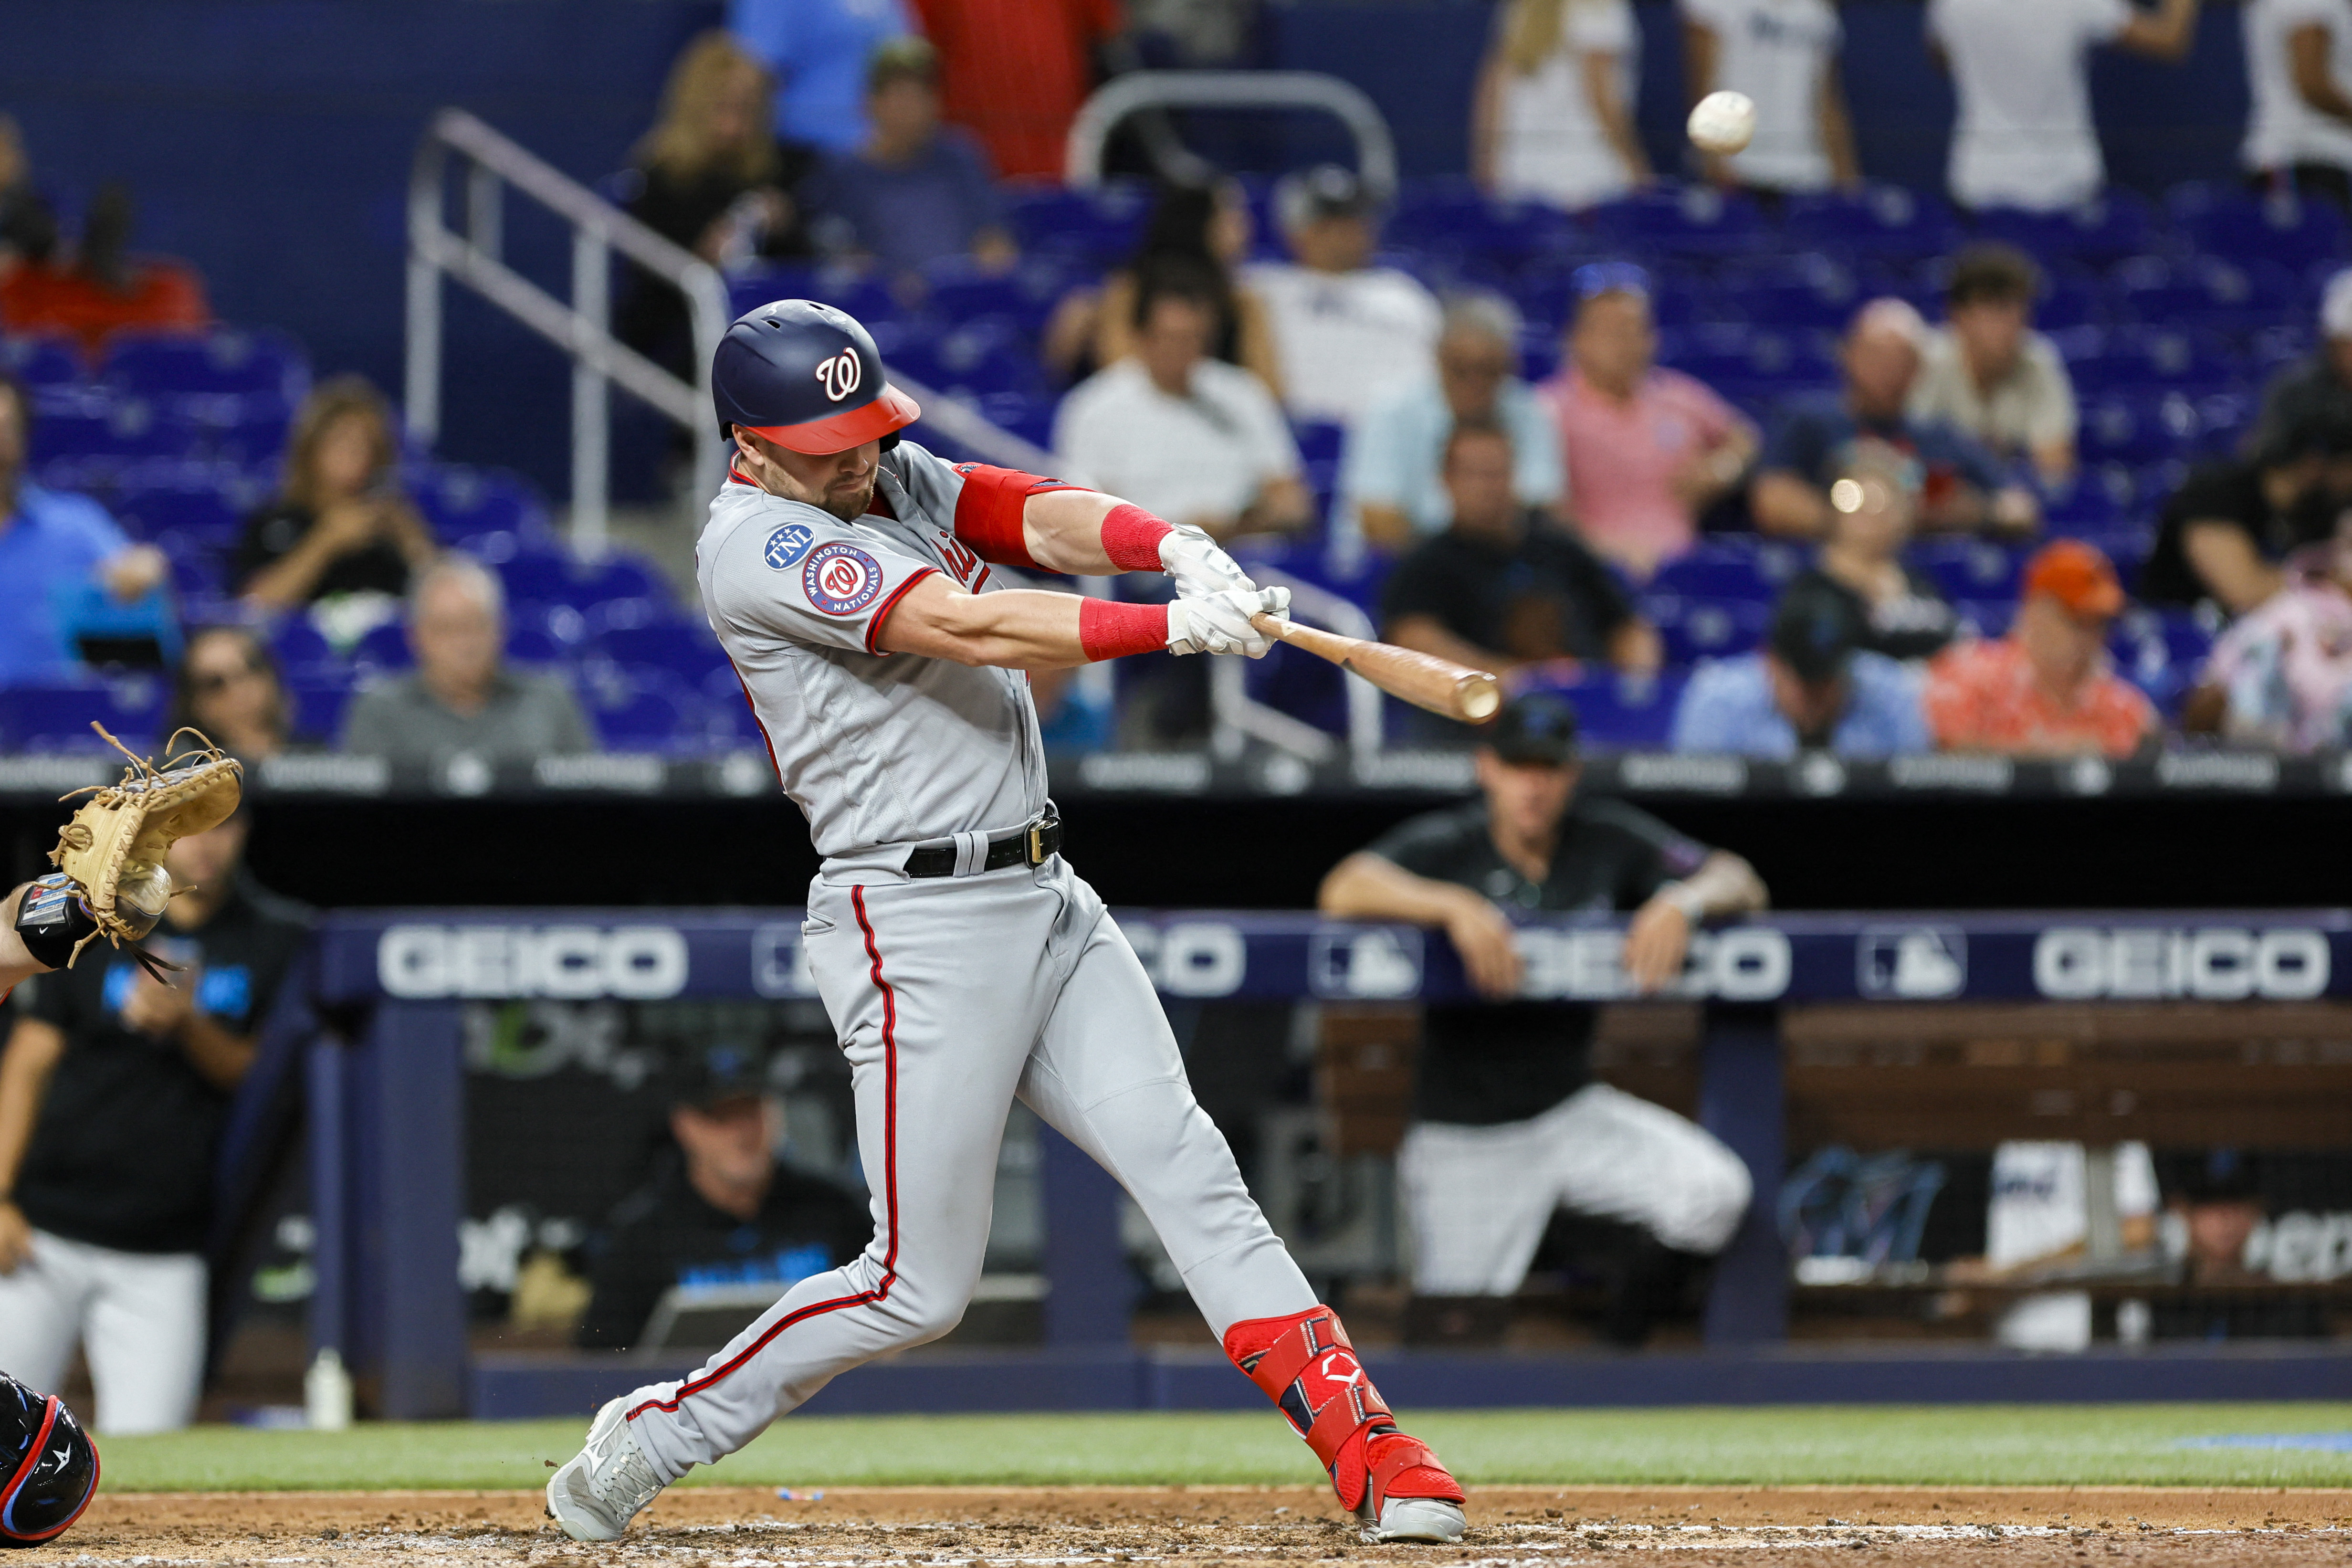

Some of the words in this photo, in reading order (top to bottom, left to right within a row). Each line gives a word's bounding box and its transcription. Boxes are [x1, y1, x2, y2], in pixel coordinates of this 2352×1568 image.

[815, 347, 861, 401] W
[766, 528, 814, 567] TNL
[806, 547, 857, 597] WASHINGTON
[834, 567, 878, 611] NATIONALS
[377, 923, 689, 999] GEICO
[2032, 926, 2332, 1000] GEICO
[1306, 1320, 1317, 1352] EVOSHIELD
[1353, 1387, 1365, 1419] EVOSHIELD
